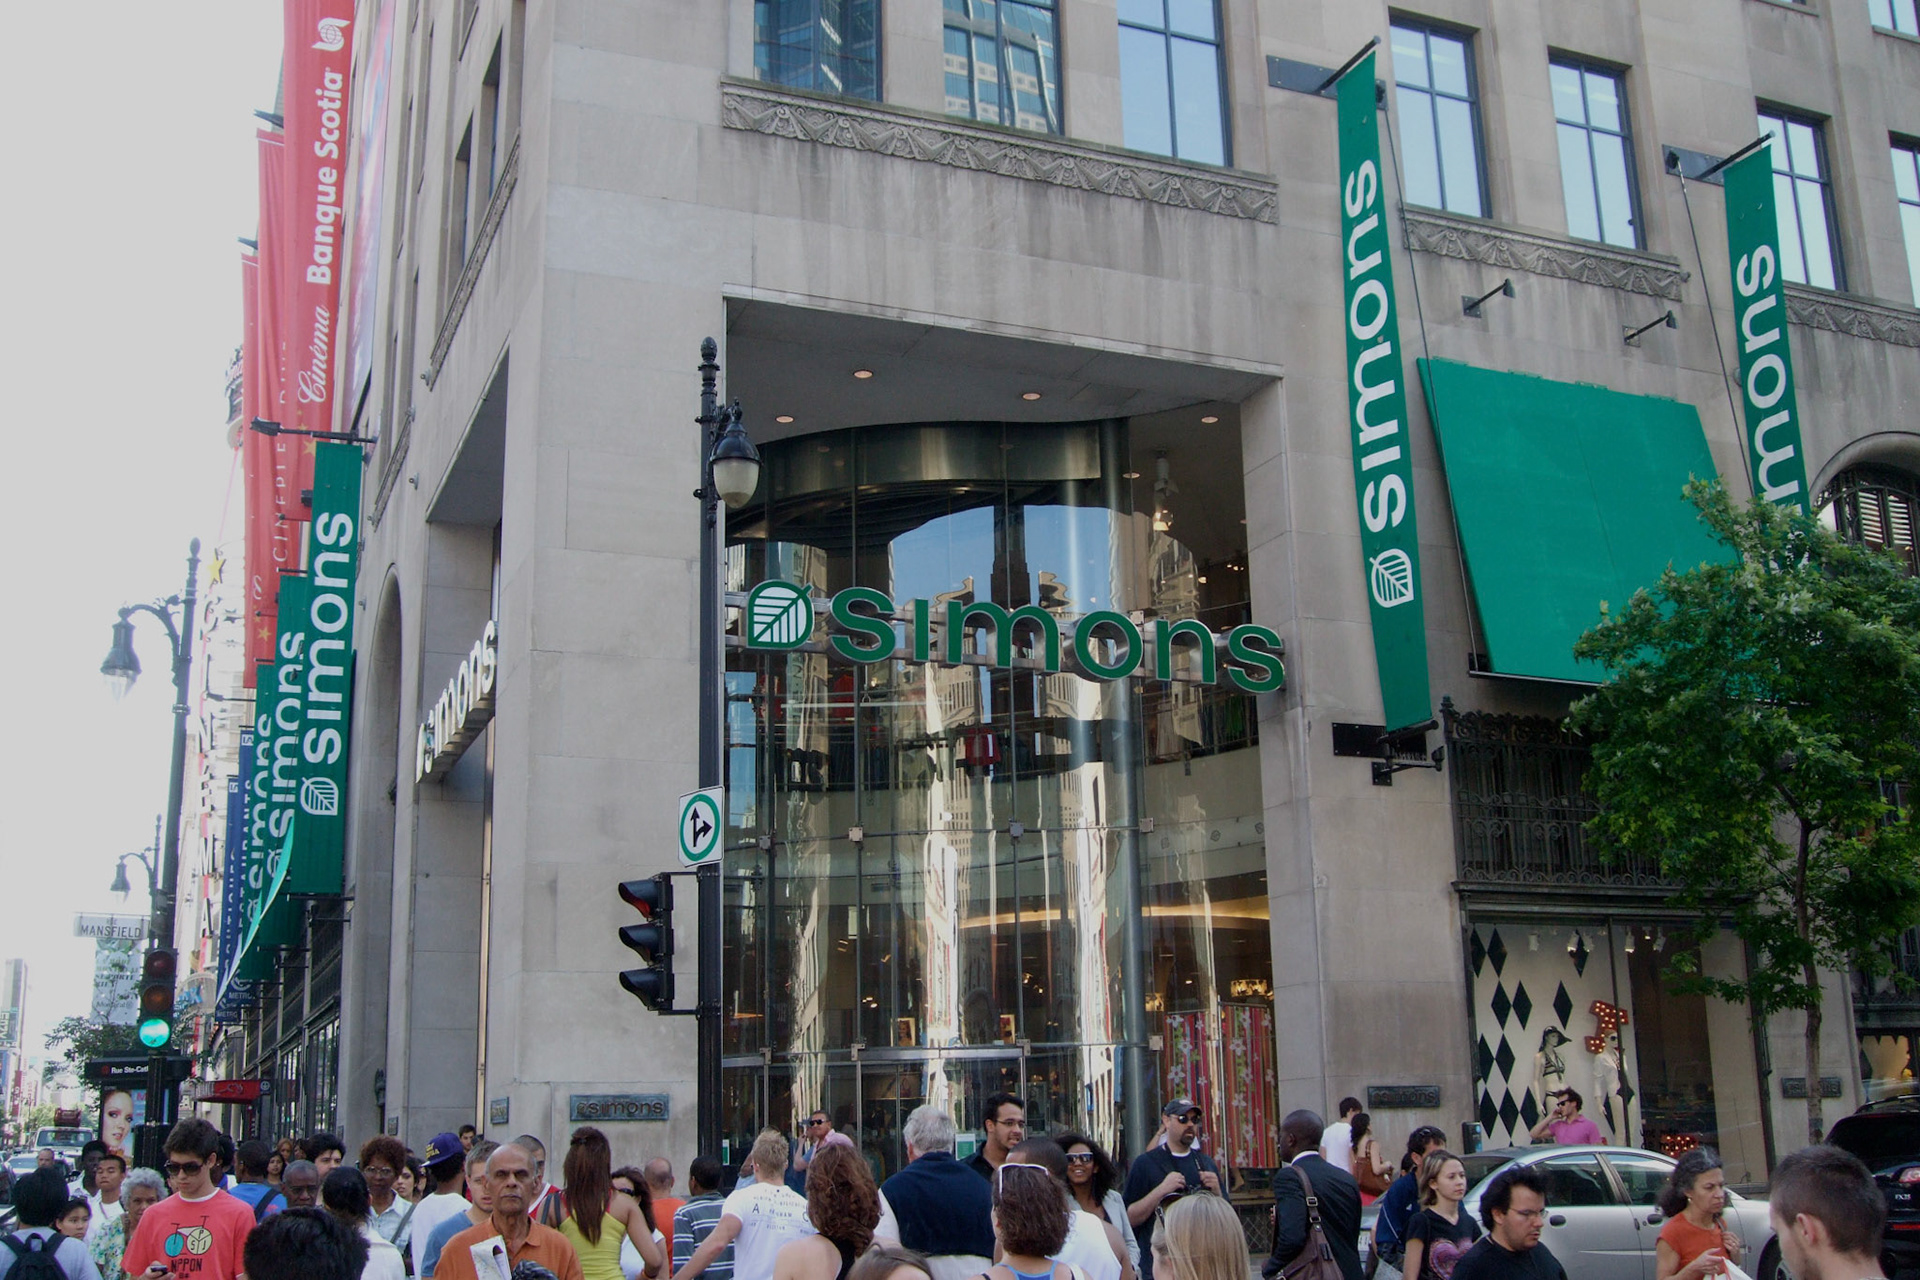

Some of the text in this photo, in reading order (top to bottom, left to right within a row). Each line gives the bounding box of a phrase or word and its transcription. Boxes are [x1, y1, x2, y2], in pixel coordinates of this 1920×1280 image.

[298, 71, 343, 404] Cinéma Banque Scotia
[1346, 158, 1407, 534] simons
[303, 512, 354, 765] simons
[425, 620, 496, 775] simons
[830, 586, 1285, 693] simons
[80, 924, 141, 938] MANSFIELD
[111, 1066, 123, 1074] Rue
[588, 1102, 664, 1115] simons
